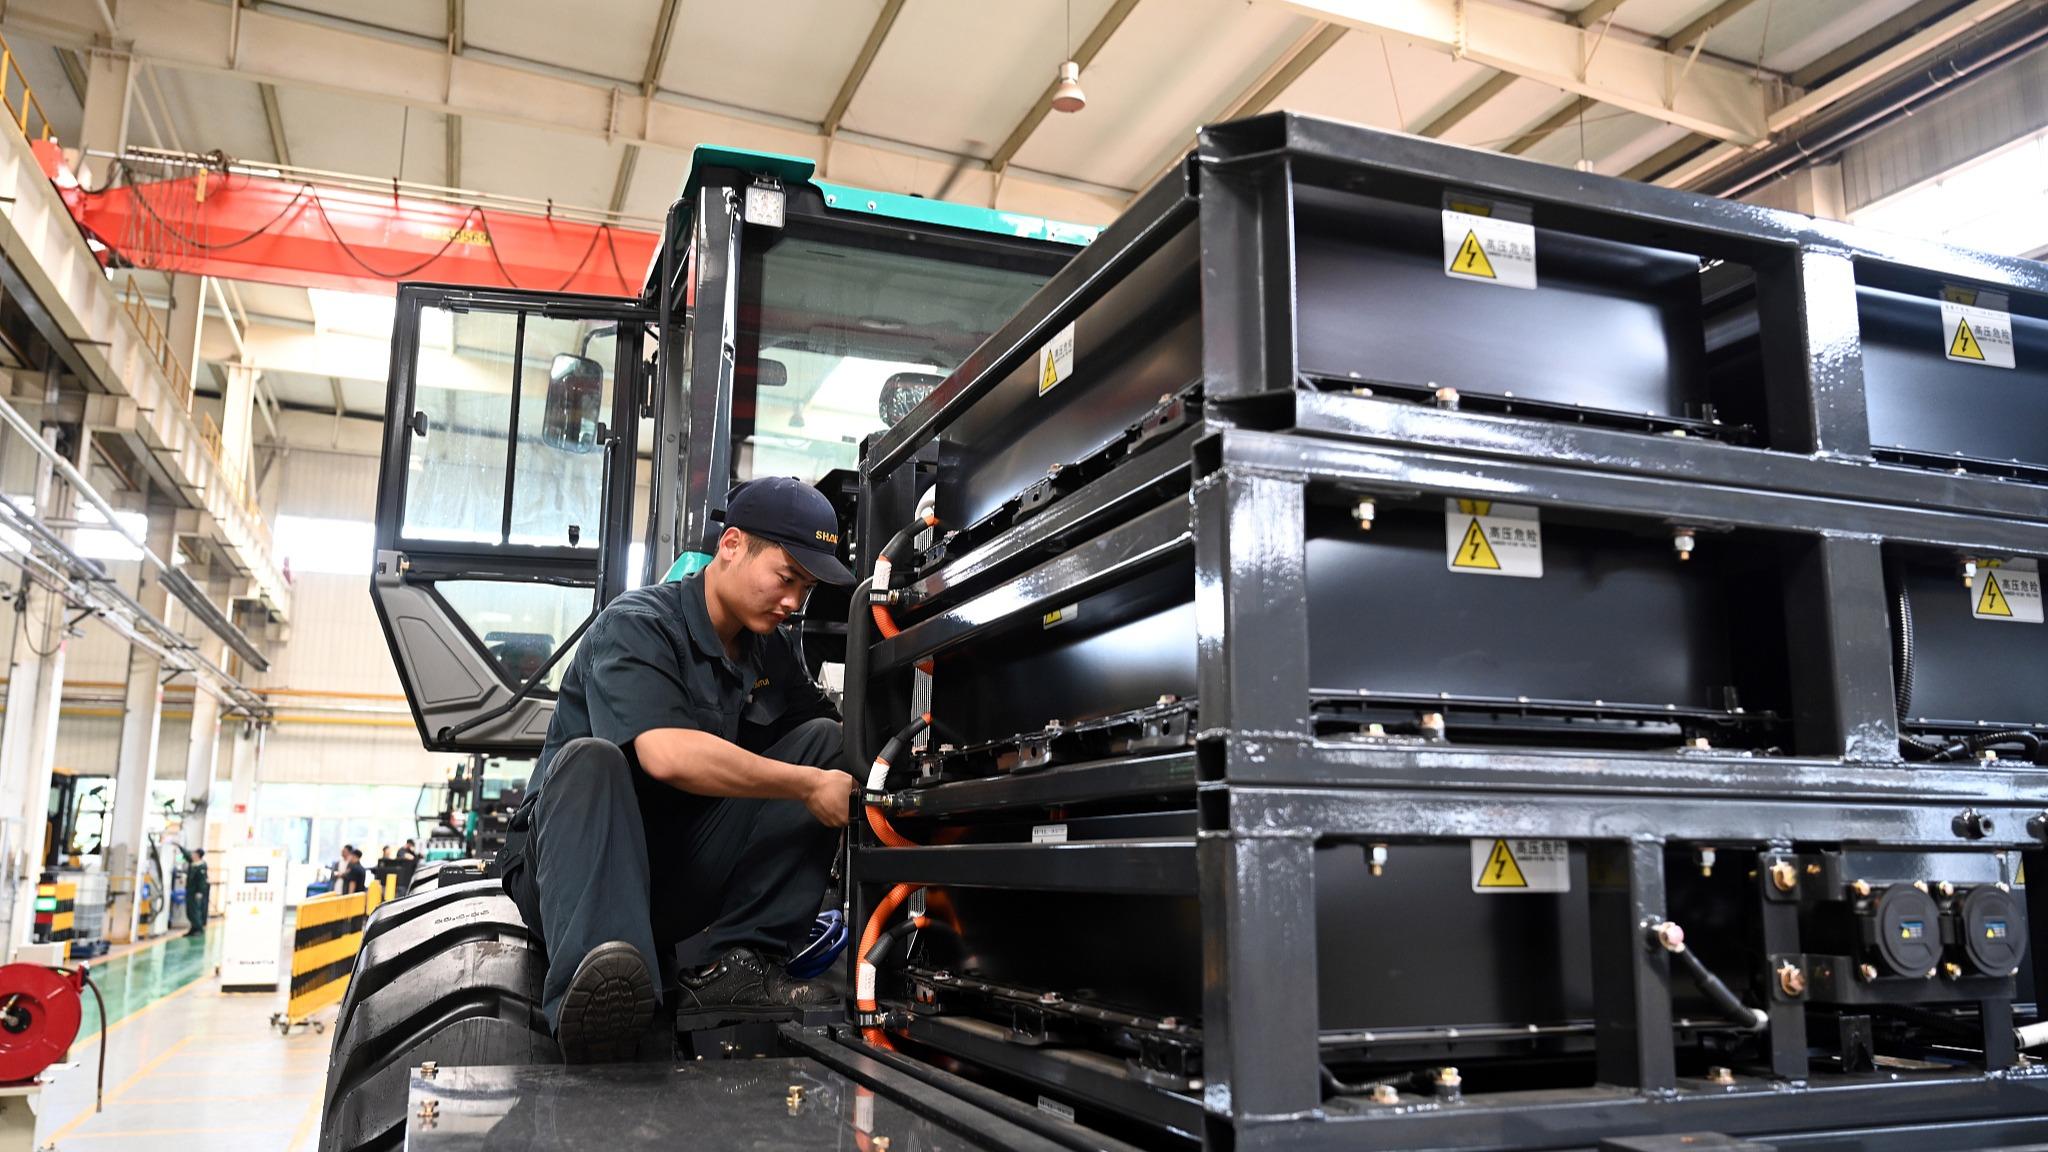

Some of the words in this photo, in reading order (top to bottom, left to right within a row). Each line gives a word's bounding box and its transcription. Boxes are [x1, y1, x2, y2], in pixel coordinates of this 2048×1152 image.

[1975, 325, 2010, 340] 高压危险
[1490, 527, 1537, 543] 高压危险
[2002, 579, 2039, 593] 高压危险
